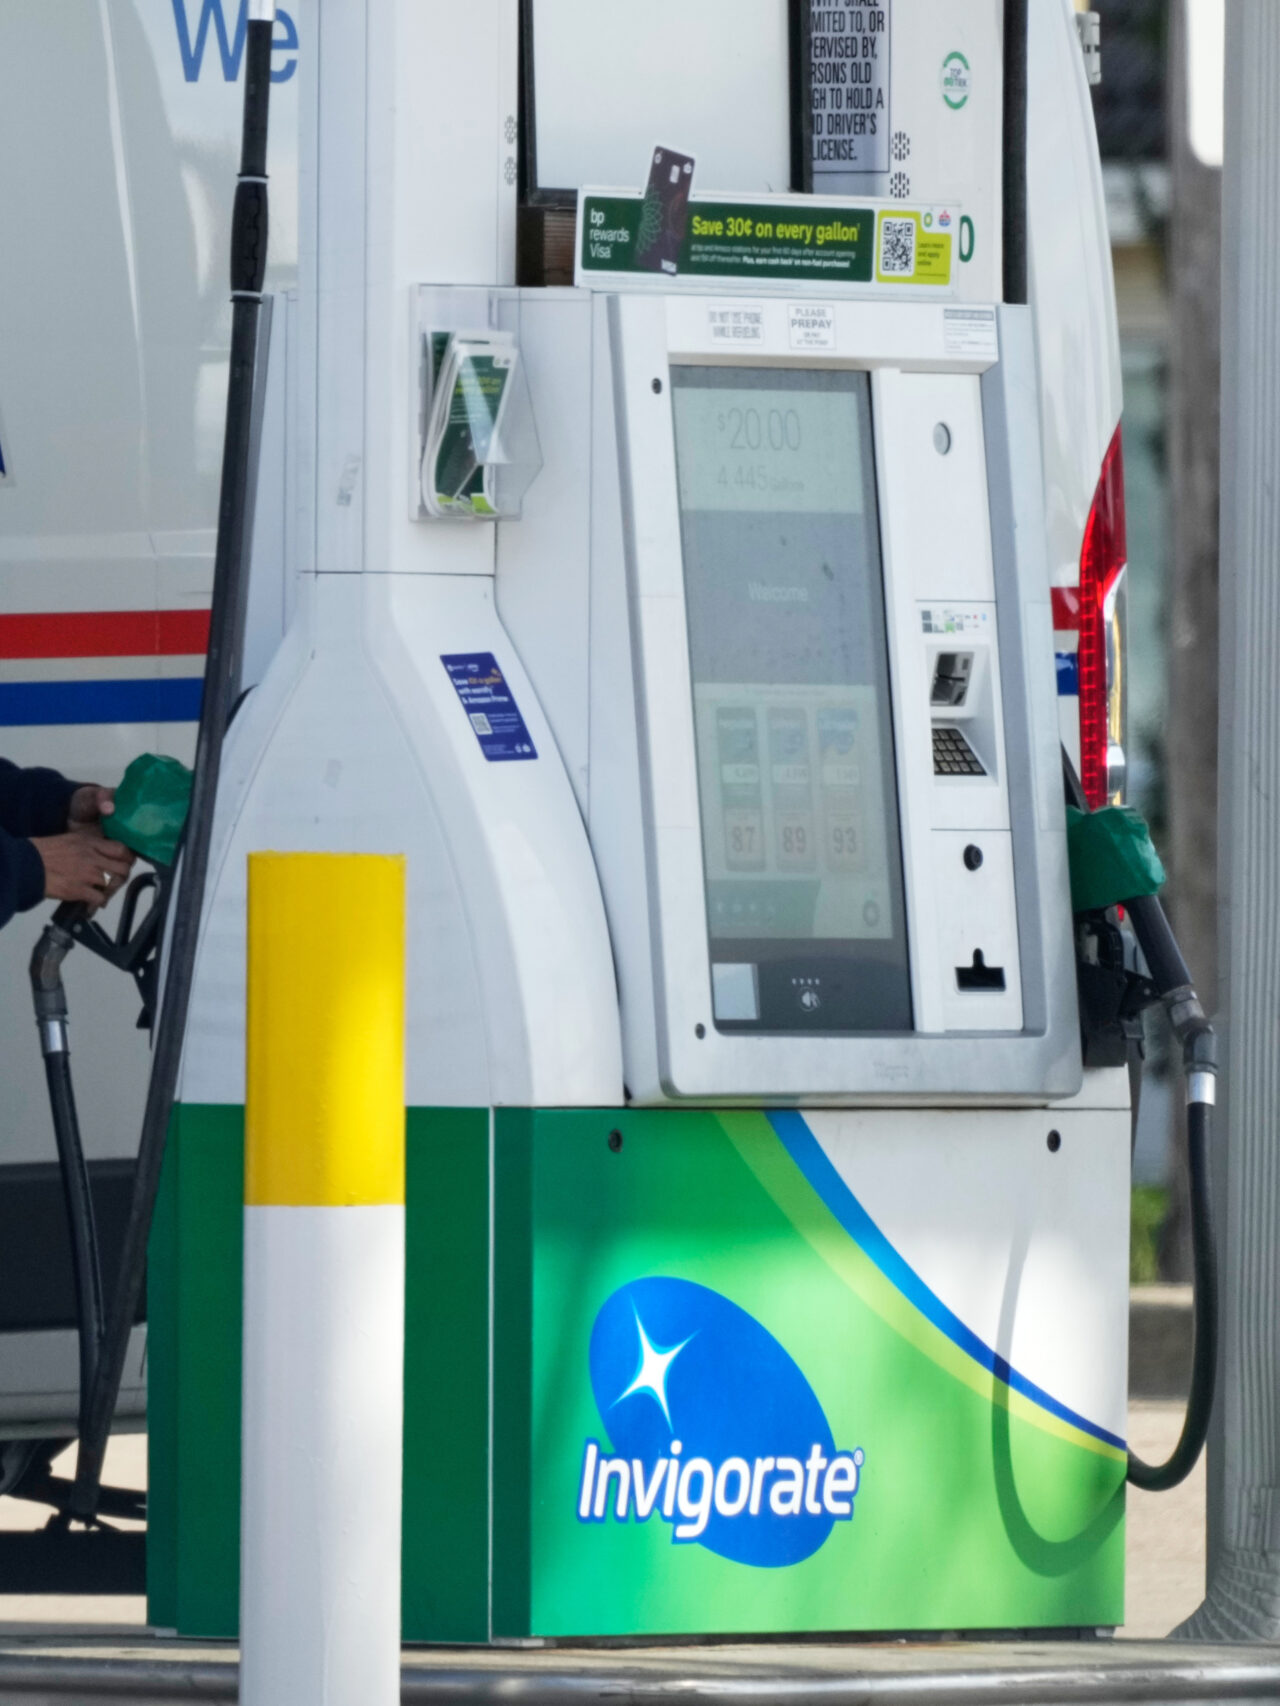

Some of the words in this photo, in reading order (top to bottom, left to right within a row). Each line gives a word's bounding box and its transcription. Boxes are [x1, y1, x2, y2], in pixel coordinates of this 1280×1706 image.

[849, 11, 866, 34] TO,
[869, 11, 885, 33] OR
[172, 0, 299, 83] We
[862, 36, 878, 60] BY,
[851, 62, 872, 84] OLD
[829, 87, 843, 110] TO
[846, 87, 873, 110] HOLD
[875, 87, 885, 110] A
[827, 113, 877, 136] DRIVER'S
[590, 208, 605, 228] bp
[589, 227, 630, 243] rewards
[691, 215, 723, 236] Save
[726, 217, 753, 237] 30¢
[755, 222, 773, 239] on
[775, 223, 813, 245] every
[790, 318, 832, 329] PREPAY
[795, 307, 827, 318] PLEASE
[731, 825, 756, 854] 87
[782, 825, 807, 854] 89
[832, 826, 857, 854] 93
